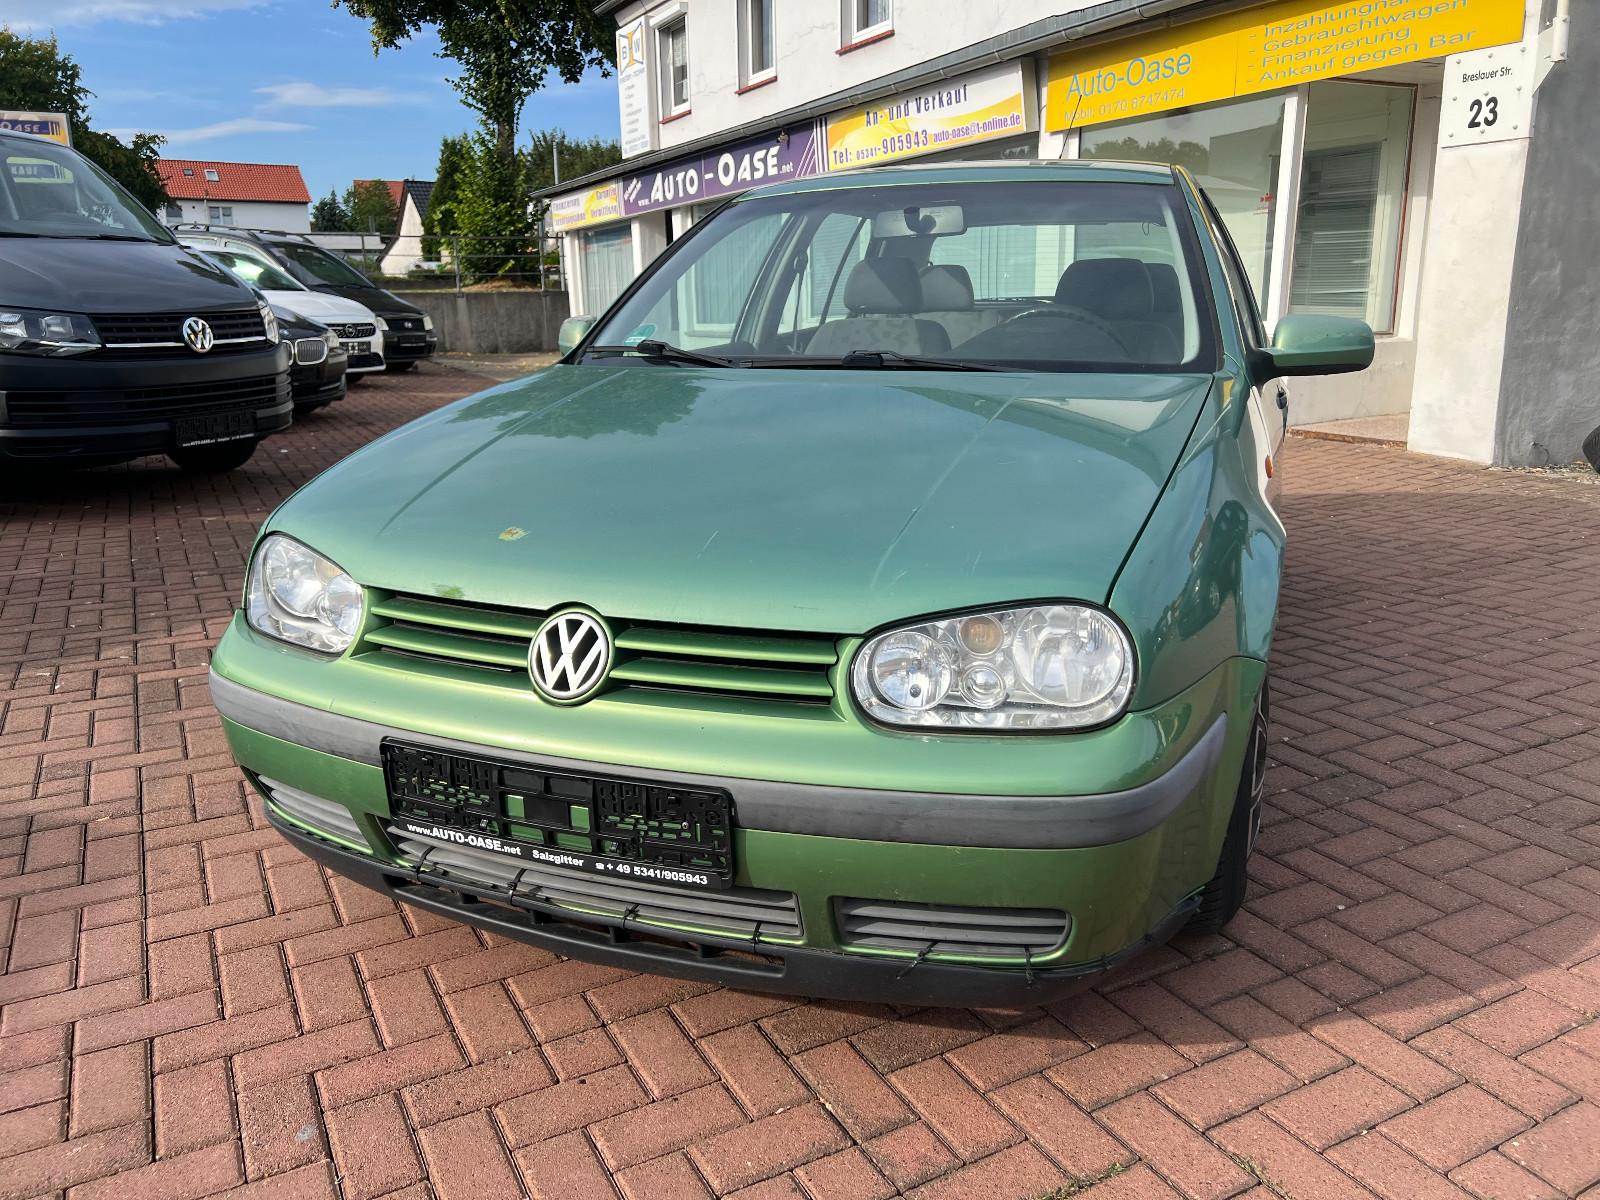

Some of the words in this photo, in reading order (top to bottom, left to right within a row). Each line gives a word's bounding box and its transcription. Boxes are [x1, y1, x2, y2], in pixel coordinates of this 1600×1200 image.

[1263, 0, 1467, 52] Gebrauchtwagen
[1264, 0, 1410, 37] Inzahlungna
[1259, 57, 1336, 83] Ankauf
[1342, 43, 1418, 68] gegen
[1429, 30, 1477, 49] Bar
[1262, 27, 1410, 68] Finanzierung
[1066, 52, 1191, 102] Auto-Oase
[1462, 69, 1498, 83] Breslauer
[1500, 66, 1513, 77] Str.
[865, 111, 884, 128] An-
[888, 100, 910, 121] und
[915, 84, 968, 114] Verkauf
[1099, 100, 1129, 117] 0170
[1468, 96, 1498, 128] 23
[833, 148, 852, 165] Tel:
[933, 112, 1021, 143] auto-oase@t-online.de
[406, 823, 522, 856] www.AUTO-OASE.net
[532, 850, 584, 867] Salzgitter
[615, 864, 631, 874] 49
[633, 866, 708, 885] 5341/905943
